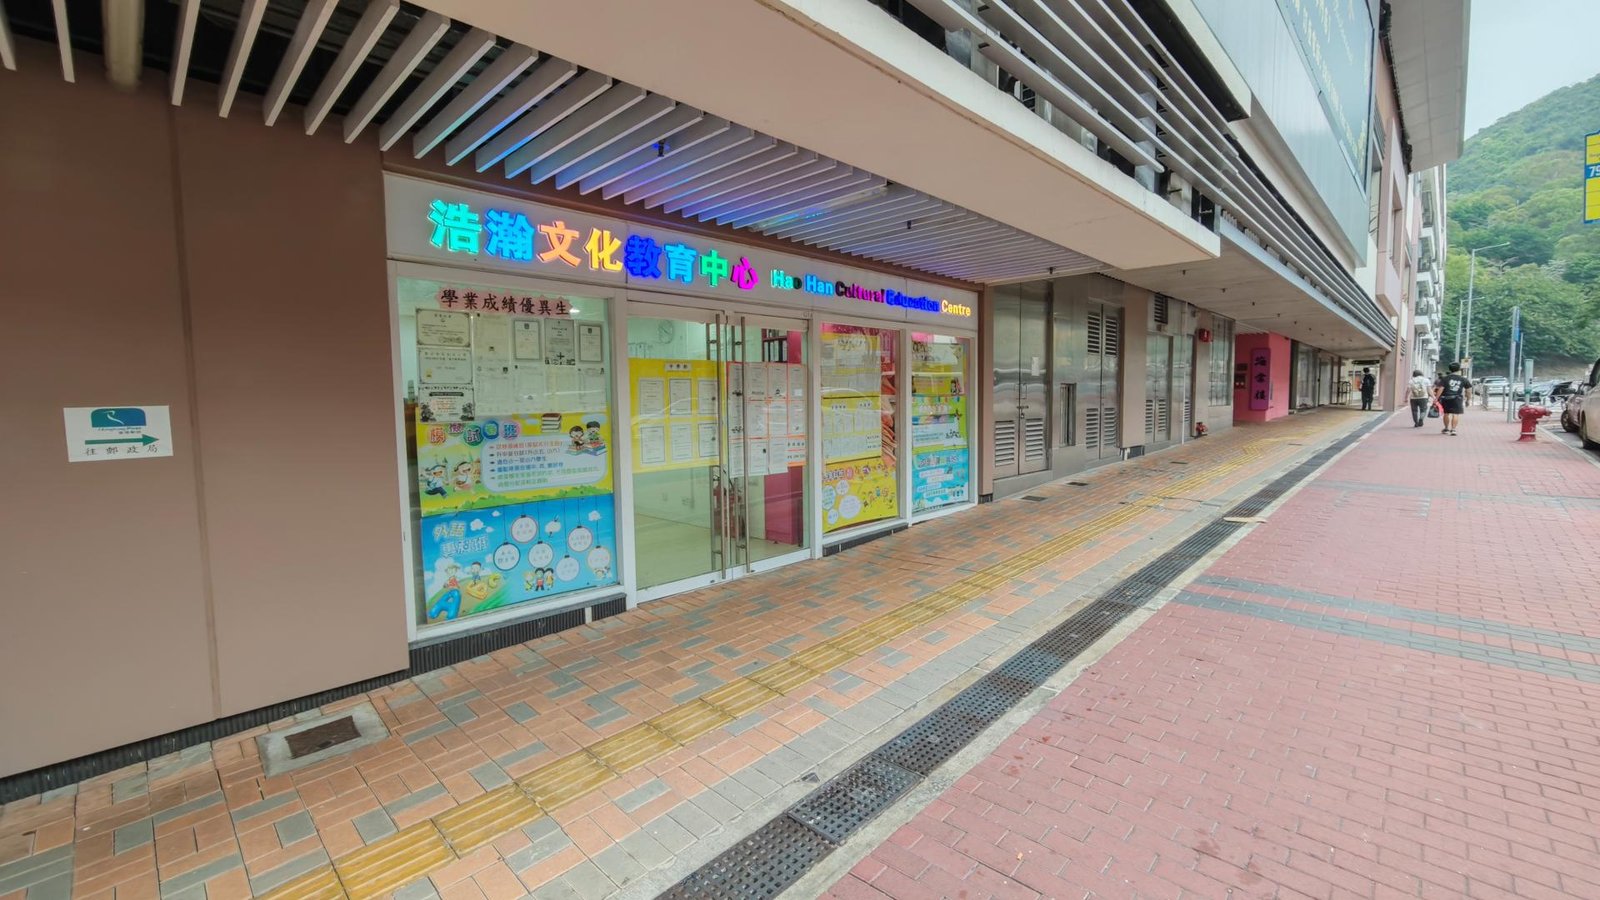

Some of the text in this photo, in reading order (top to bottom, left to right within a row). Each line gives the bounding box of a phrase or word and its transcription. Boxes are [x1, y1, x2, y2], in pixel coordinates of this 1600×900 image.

[427, 199, 759, 291] 浩瀚文化教育中心
[440, 289, 569, 316] 學業成績優異生
[771, 268, 971, 317] Hao Han Cultural Education Centre
[85, 444, 158, 456] 往郵政局
